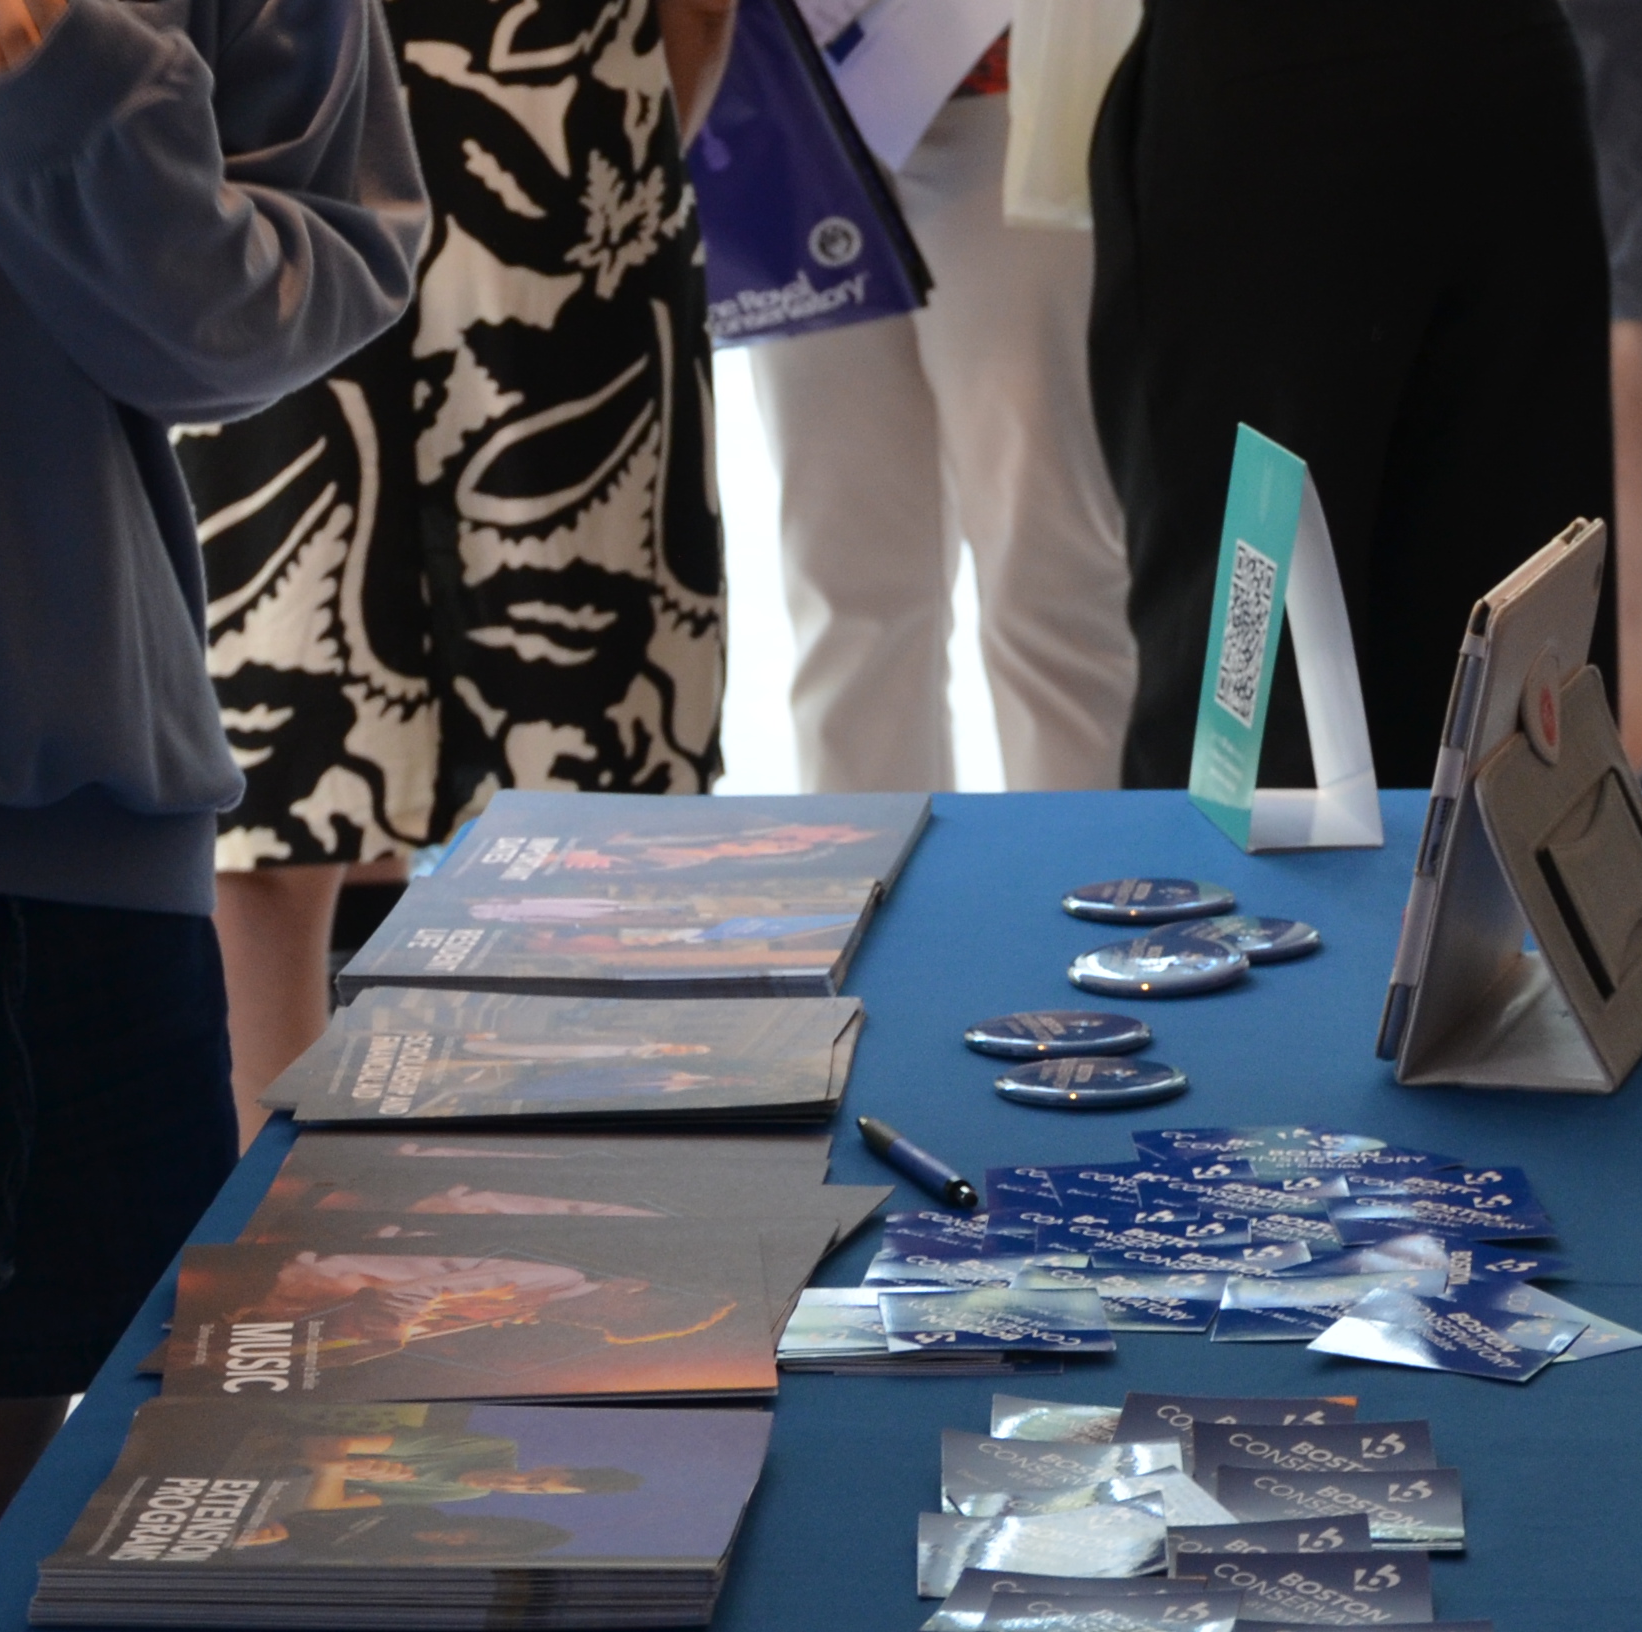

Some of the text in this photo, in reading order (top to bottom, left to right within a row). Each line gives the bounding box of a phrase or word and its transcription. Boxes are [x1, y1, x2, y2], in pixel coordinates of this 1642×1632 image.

[223, 1321, 295, 1393] MUSIC
[1447, 1311, 1522, 1353] BOSTON
[109, 1477, 209, 1561] PROGRAMS
[160, 1478, 260, 1562] EXTENSION
[1316, 1485, 1424, 1528] BOSTON
[1277, 1571, 1393, 1623] BOSTON
